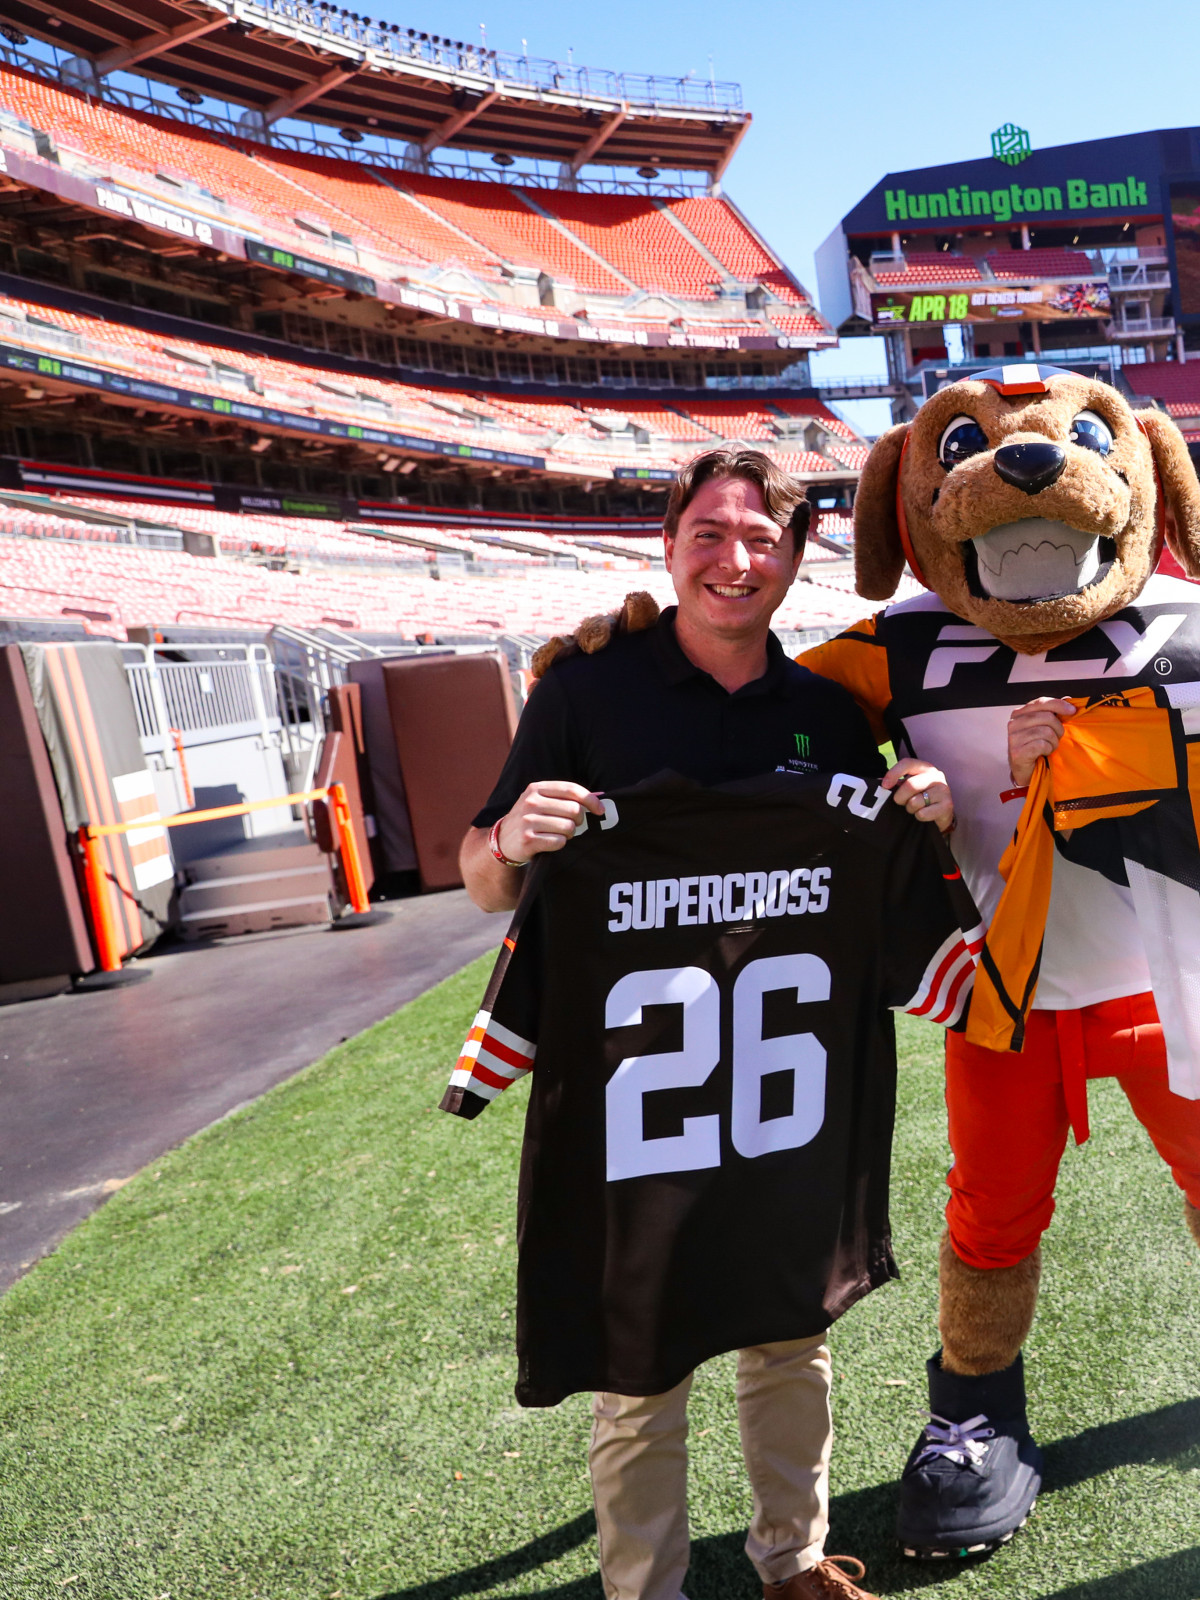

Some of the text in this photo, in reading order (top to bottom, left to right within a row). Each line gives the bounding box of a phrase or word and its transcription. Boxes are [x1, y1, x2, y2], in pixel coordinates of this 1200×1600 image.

[884, 176, 1148, 222] Huntington Bank
[909, 296, 946, 322] APR
[948, 294, 968, 320] 18
[922, 614, 1188, 690] FLY
[608, 866, 832, 933] SUPERCROSS
[605, 953, 832, 1182] 26
